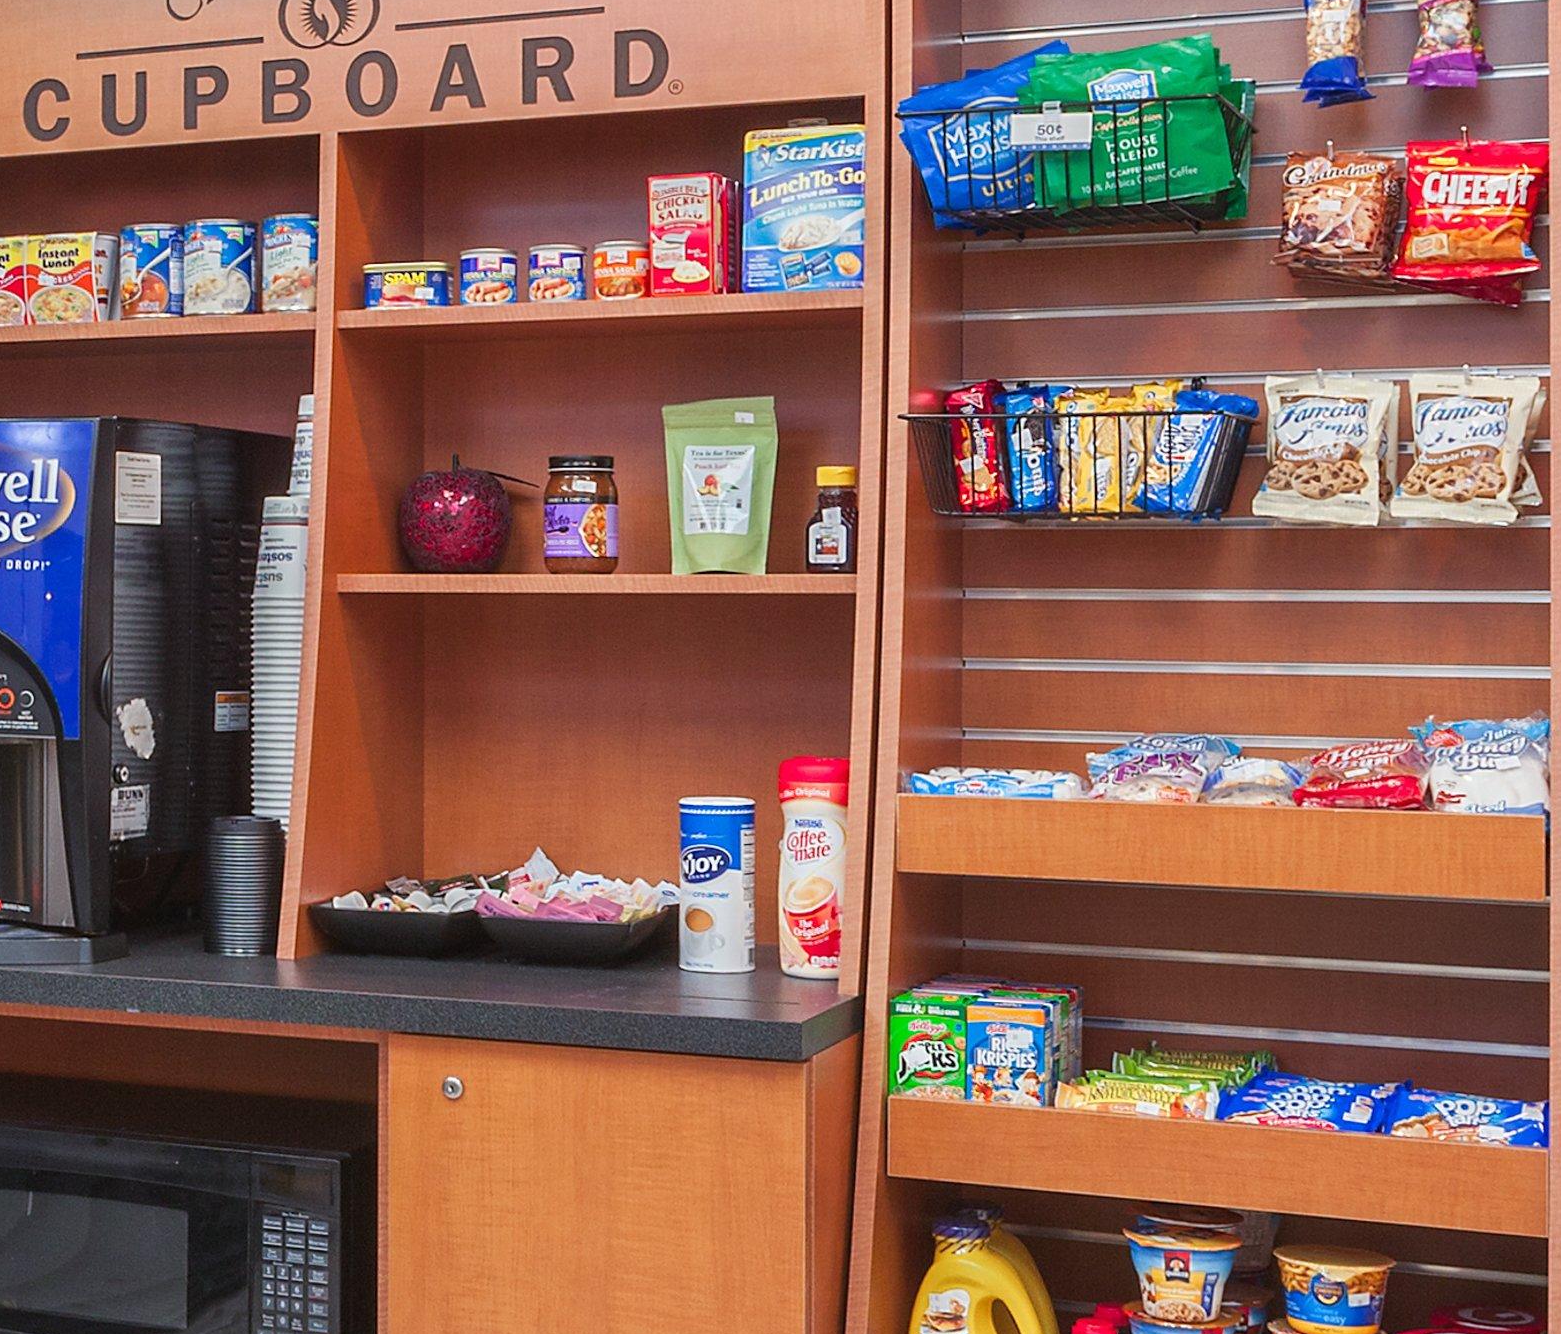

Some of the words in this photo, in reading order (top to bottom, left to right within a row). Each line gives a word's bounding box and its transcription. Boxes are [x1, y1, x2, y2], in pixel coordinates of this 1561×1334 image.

[23, 26, 671, 143] CUPBOARD
[1093, 75, 1150, 97] Maxwell
[1037, 123, 1064, 135] 50¢
[774, 140, 865, 163] StarKist
[1169, 166, 1198, 179] Coffee
[748, 171, 810, 209] Lunch
[38, 248, 80, 259] Instant
[43, 258, 75, 268] Lunch
[383, 270, 427, 286] SPAM
[1330, 741, 1413, 762] Honey
[116, 790, 146, 801] BUNN
[794, 844, 831, 862] mate
[793, 919, 829, 938] Original
[799, 920, 813, 929] The
[976, 1049, 1036, 1067] KRISPIES
[1323, 1315, 1347, 1325] easy
